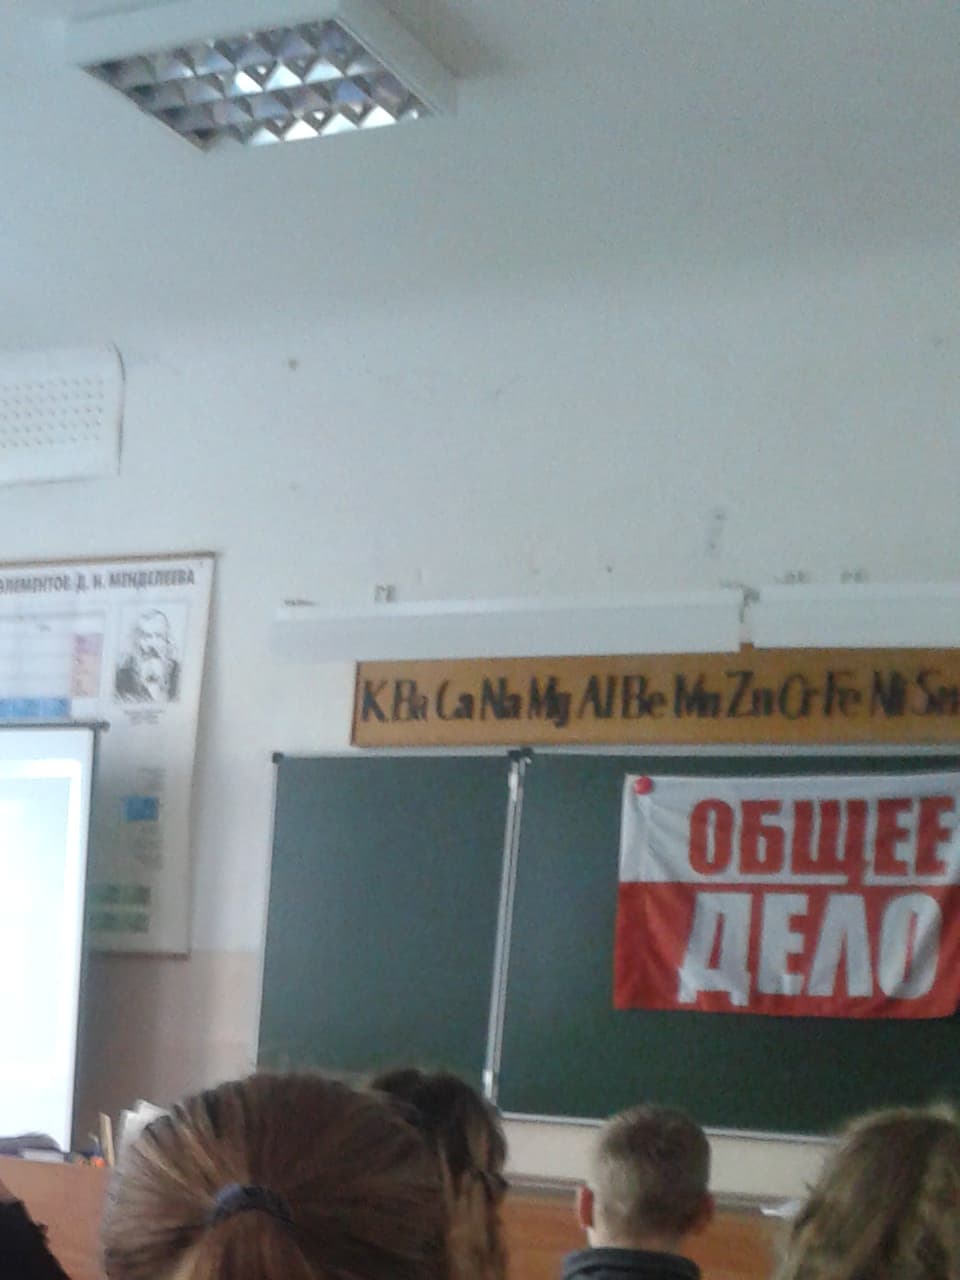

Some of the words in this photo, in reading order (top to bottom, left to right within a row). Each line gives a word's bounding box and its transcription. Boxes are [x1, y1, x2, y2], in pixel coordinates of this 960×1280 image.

[109, 569, 195, 591] МЕНДЕЛЕЕВА
[362, 679, 388, 722] K
[436, 679, 473, 720] Ca
[481, 676, 521, 720] Na
[528, 674, 571, 728] Mg
[579, 675, 616, 720] Al
[622, 675, 666, 719] Be
[725, 670, 773, 717] Zn
[688, 796, 956, 880] ОБЩЕЕ
[677, 892, 943, 1005] ДЕЛО
